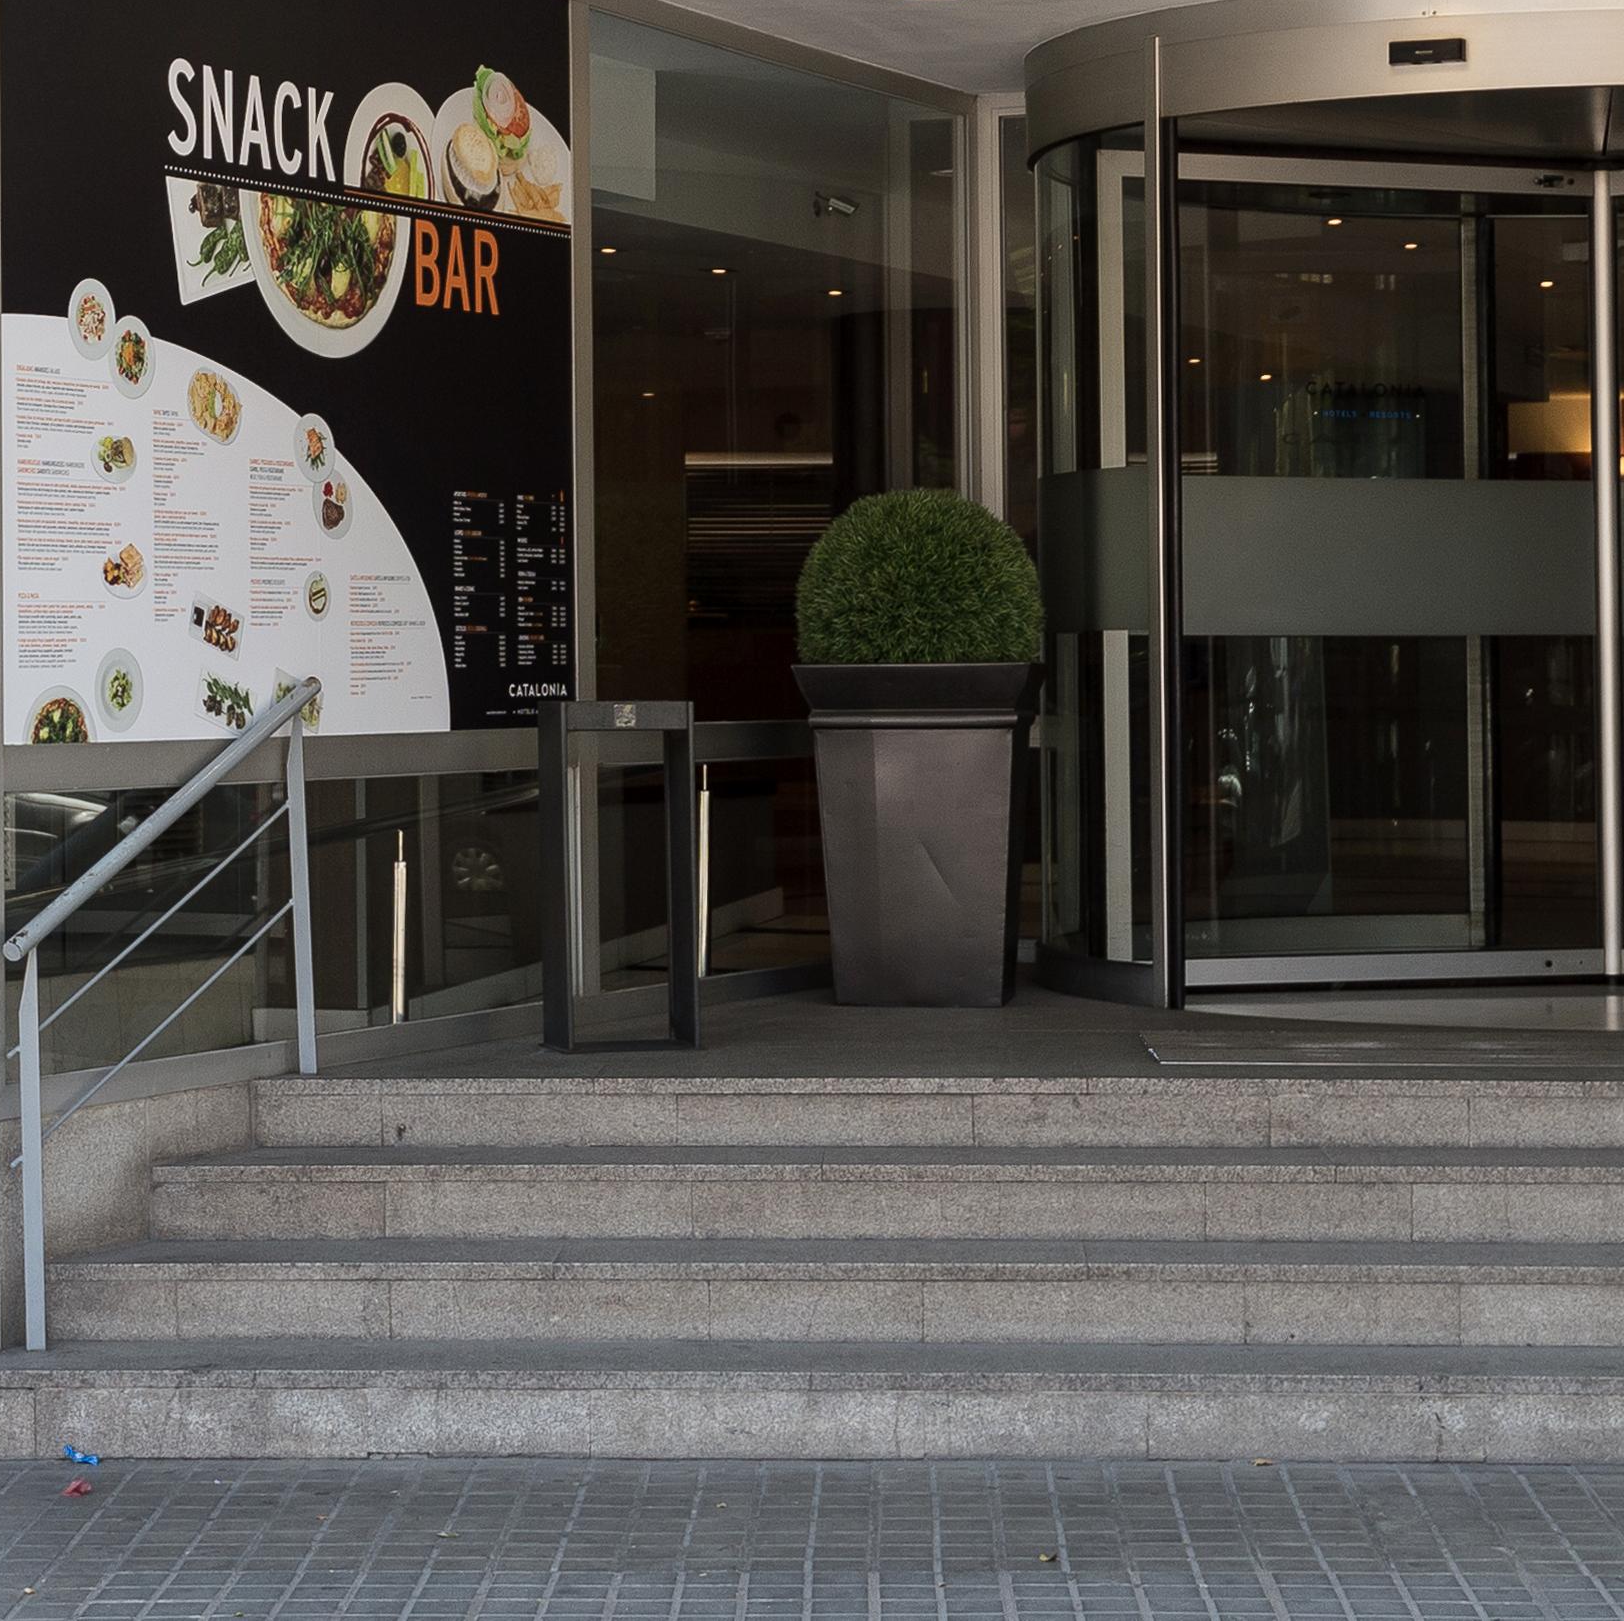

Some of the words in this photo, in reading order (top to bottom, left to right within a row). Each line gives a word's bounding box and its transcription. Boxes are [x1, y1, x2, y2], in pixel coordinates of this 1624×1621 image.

[166, 56, 337, 182] SNACK
[413, 219, 500, 316] BAR
[508, 682, 568, 698] CATALONIA
